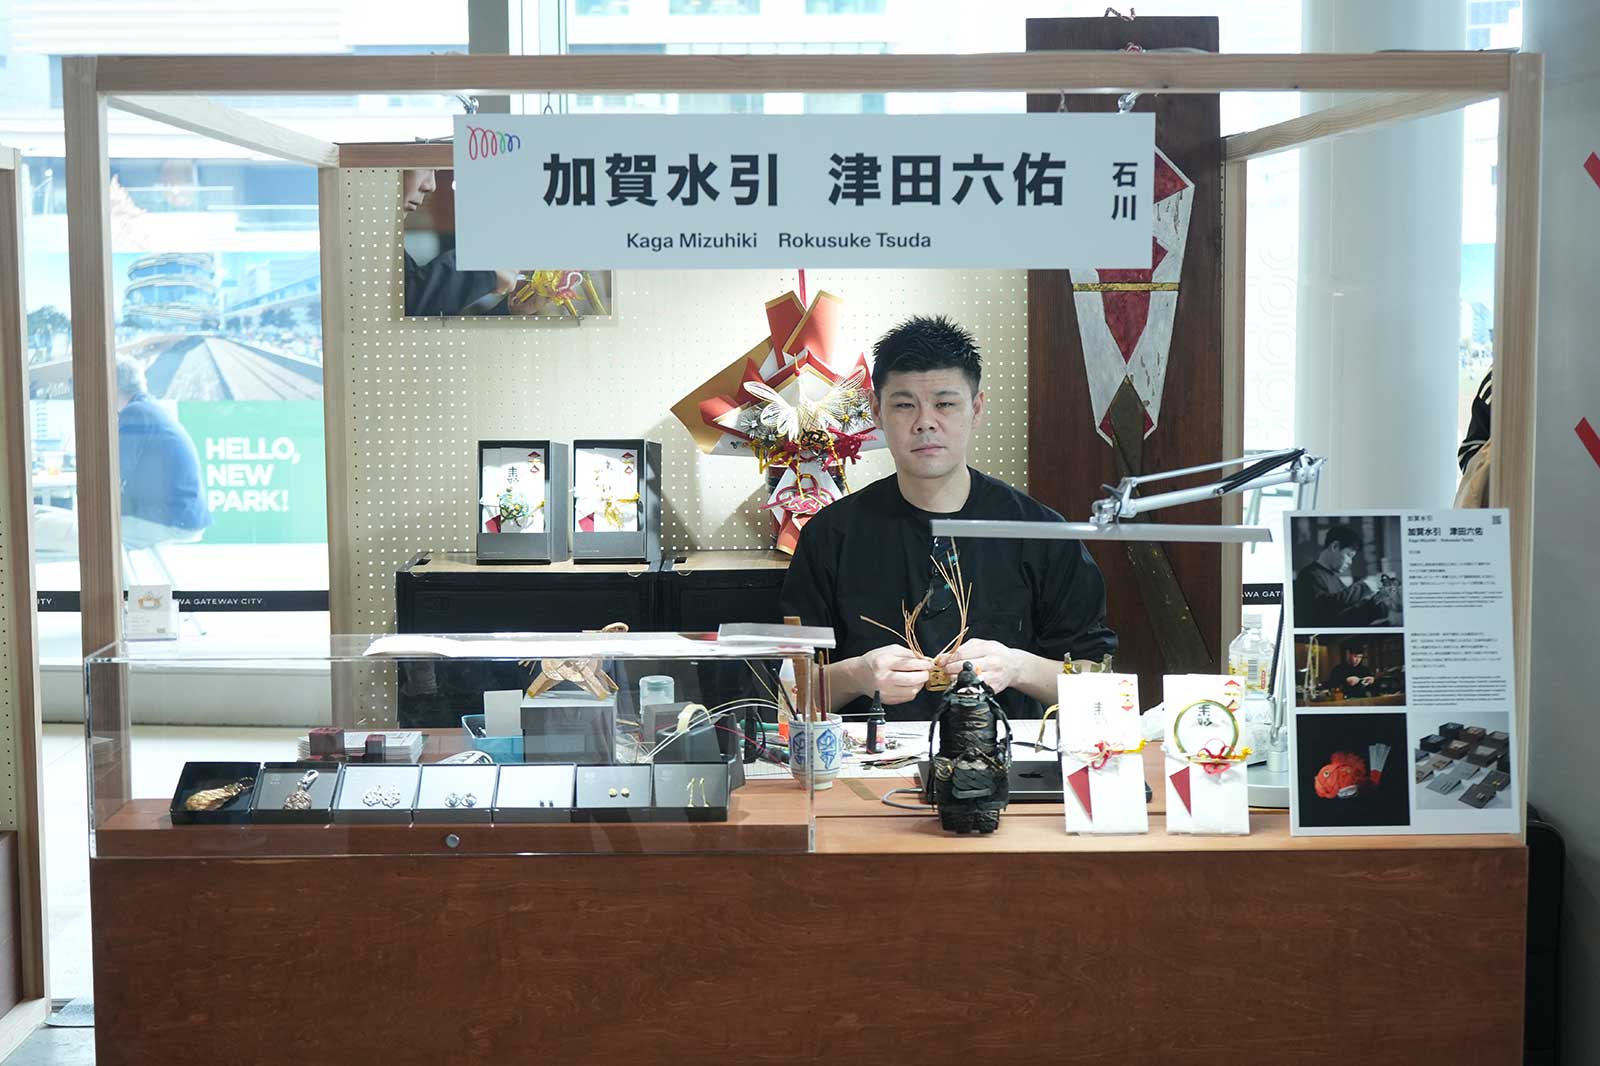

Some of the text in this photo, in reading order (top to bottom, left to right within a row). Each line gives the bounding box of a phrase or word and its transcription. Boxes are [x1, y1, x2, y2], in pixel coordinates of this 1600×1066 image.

[543, 152, 1067, 207] 加賀水引 津田六佑
[1111, 162, 1138, 221] 石川
[626, 232, 932, 252] Kaga Mizuhiki Rokusuke Tsuda
[205, 436, 301, 464] HELLO,
[206, 463, 274, 487] NEW
[207, 489, 289, 513] PARK!
[241, 597, 263, 605] CITY
